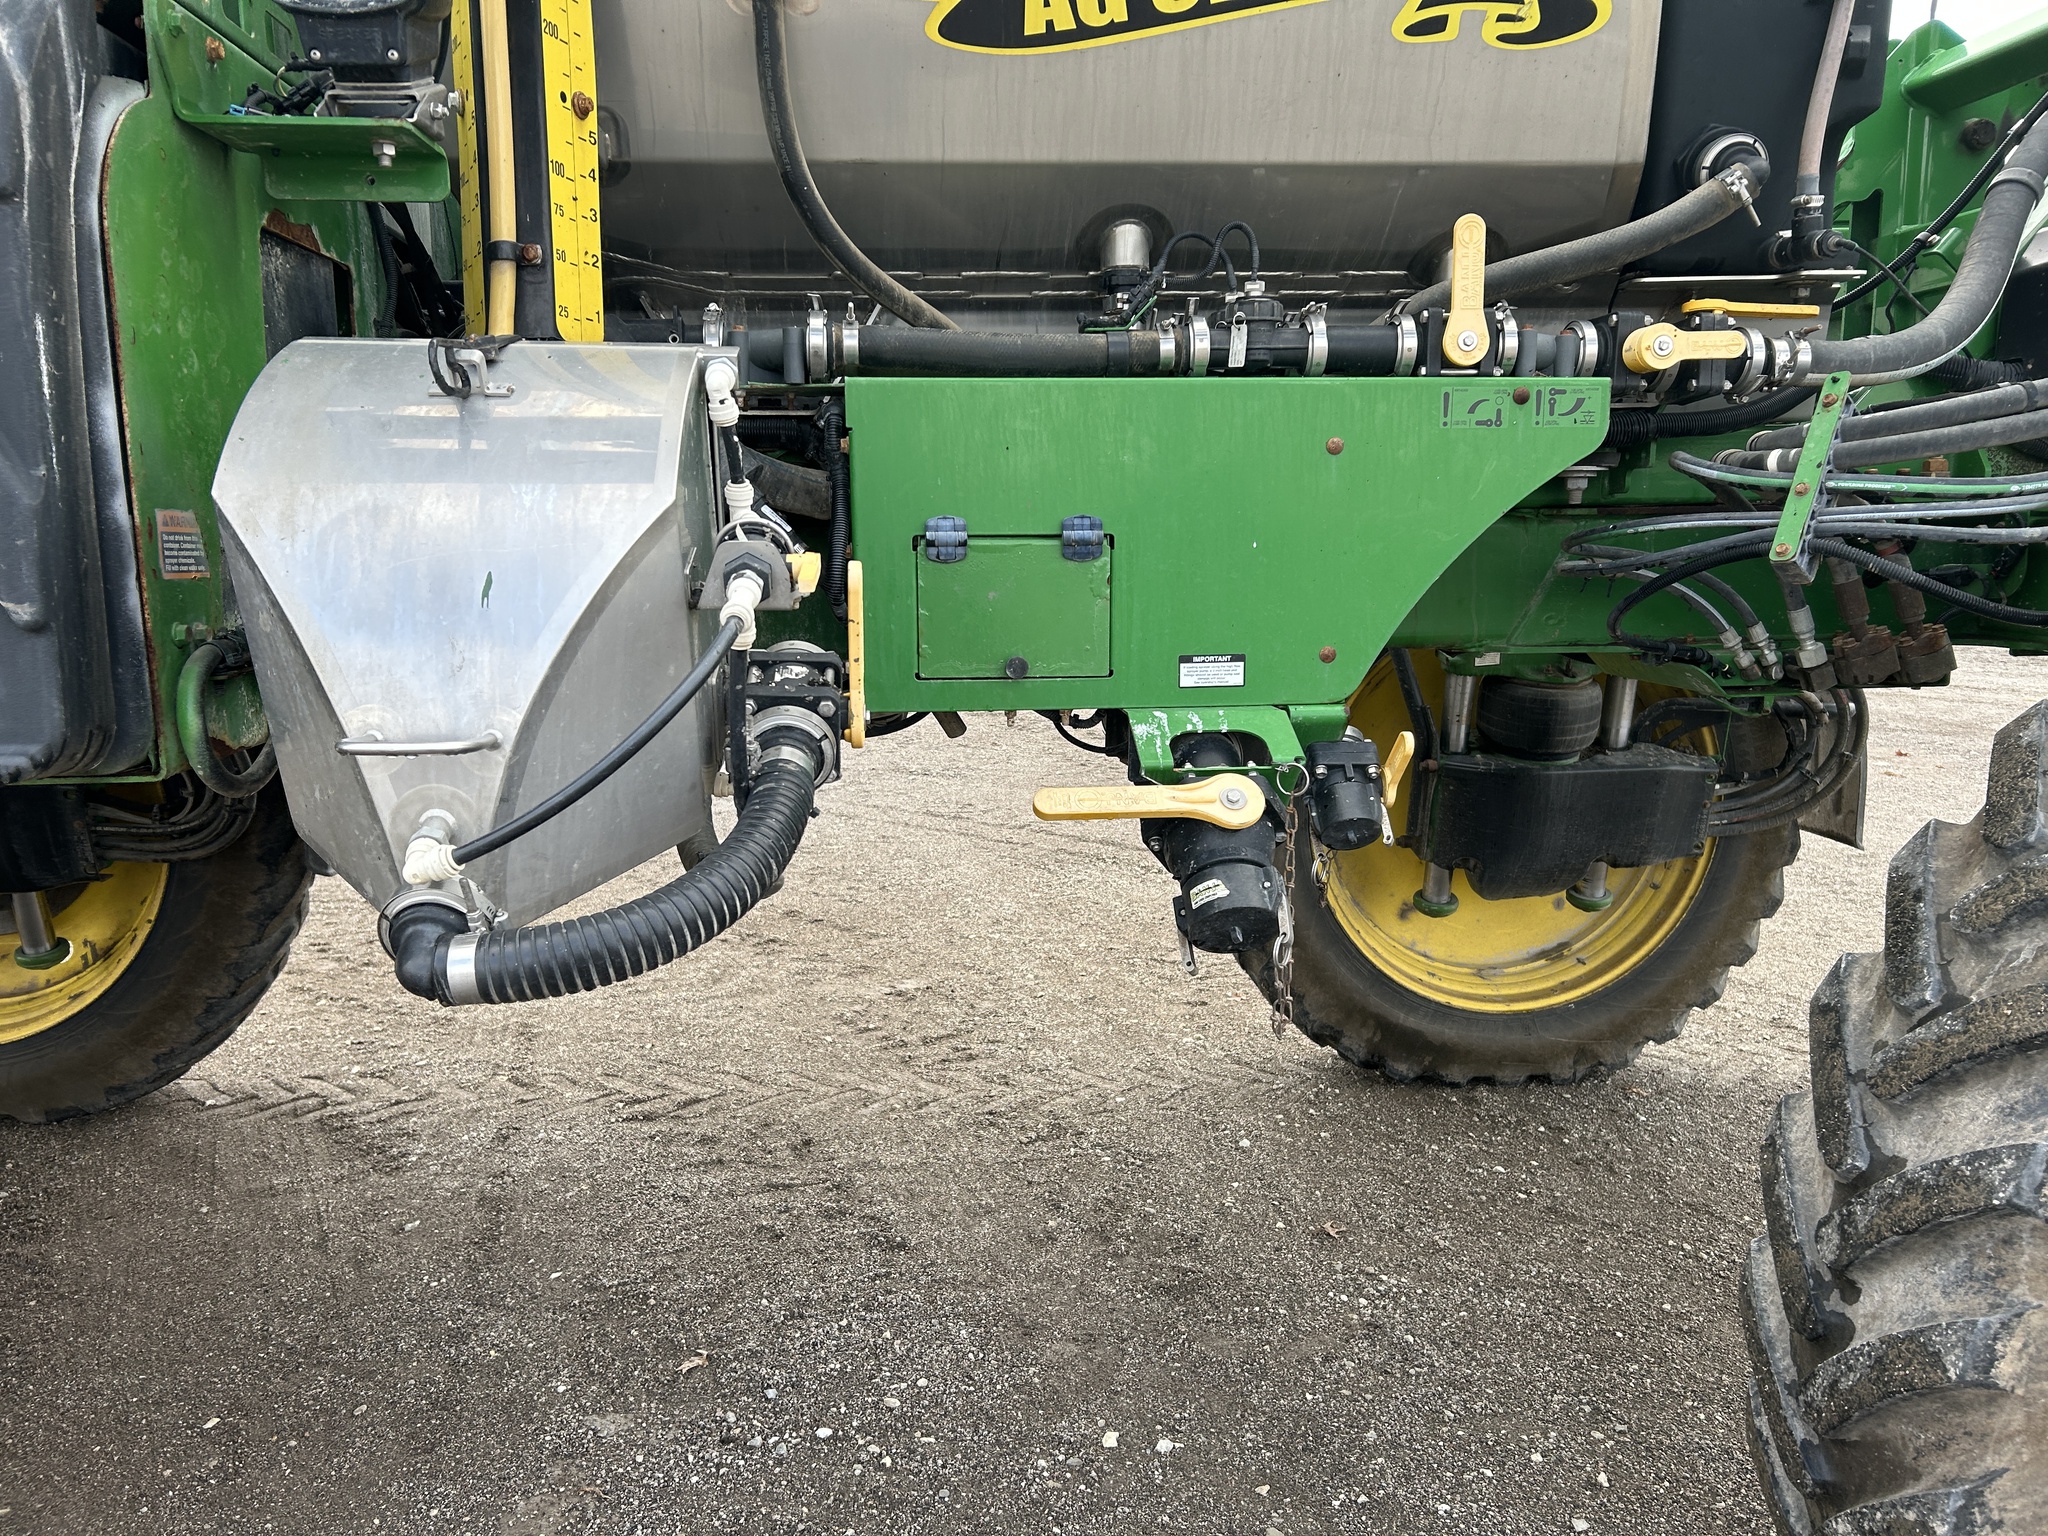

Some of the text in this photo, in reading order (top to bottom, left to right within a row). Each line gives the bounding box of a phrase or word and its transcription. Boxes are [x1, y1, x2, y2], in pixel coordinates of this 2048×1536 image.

[543, 18, 558, 40] 200
[588, 130, 597, 146] 5
[550, 159, 565, 178] 100
[588, 168, 596, 183] 4
[554, 203, 564, 217] 75
[590, 208, 598, 223] 3
[556, 249, 566, 262] 50
[592, 254, 600, 269] 2
[559, 305, 569, 318] 25
[596, 310, 600, 324] 1
